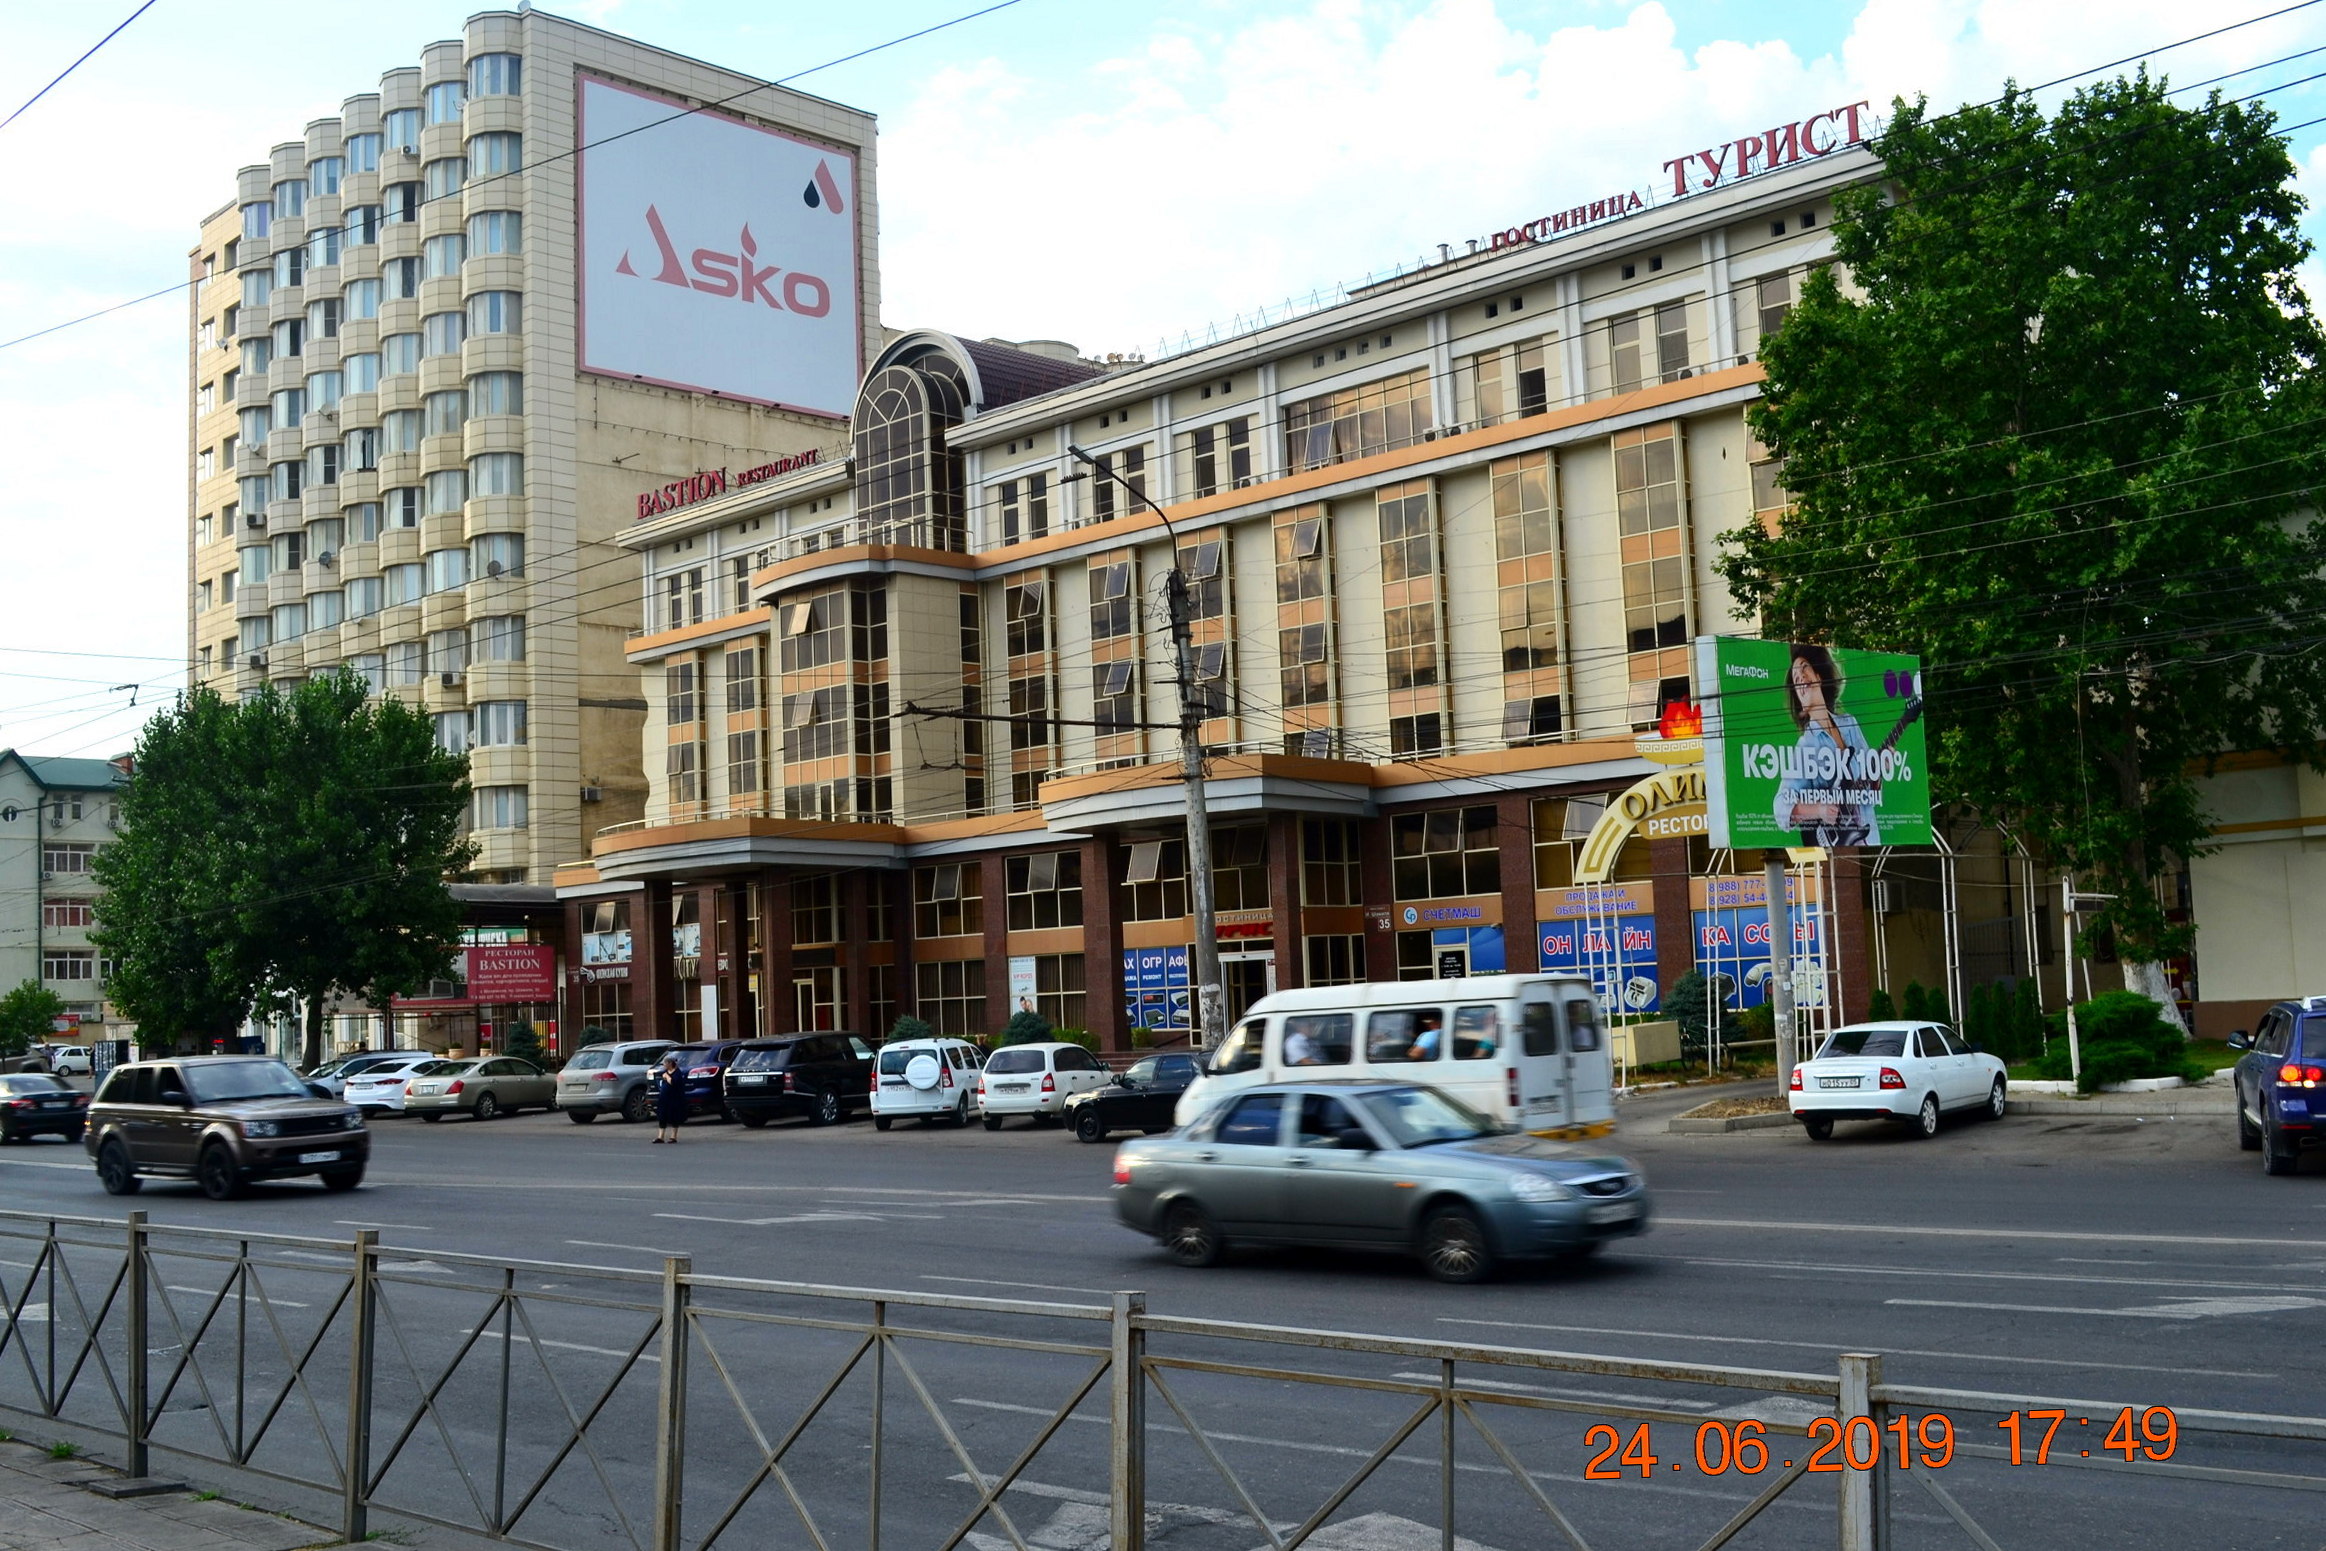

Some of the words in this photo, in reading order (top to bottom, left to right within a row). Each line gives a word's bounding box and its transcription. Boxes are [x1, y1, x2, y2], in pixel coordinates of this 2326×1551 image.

[1490, 190, 1644, 252] ГОСТИНИЦА
[1663, 100, 1870, 198] ТУРИСТ
[637, 467, 727, 519] BASTION
[737, 449, 818, 487] RESTAURANT
[1742, 743, 1851, 780] КЭШБЭК
[1854, 748, 1912, 782] 100%
[1783, 790, 1799, 805] ЗА
[1800, 787, 1844, 805] ПЕРВЫЙ
[1845, 789, 1883, 807] МЕСЯЦ
[1424, 907, 1481, 921] СЧЕТМАШ
[1379, 918, 1391, 929] 35
[1544, 935, 1572, 955] ОН
[1623, 927, 1652, 951] ЙН
[485, 949, 535, 957] РЕСТОРАН
[480, 959, 541, 971] BASTION
[1142, 956, 1163, 969] ОГР
